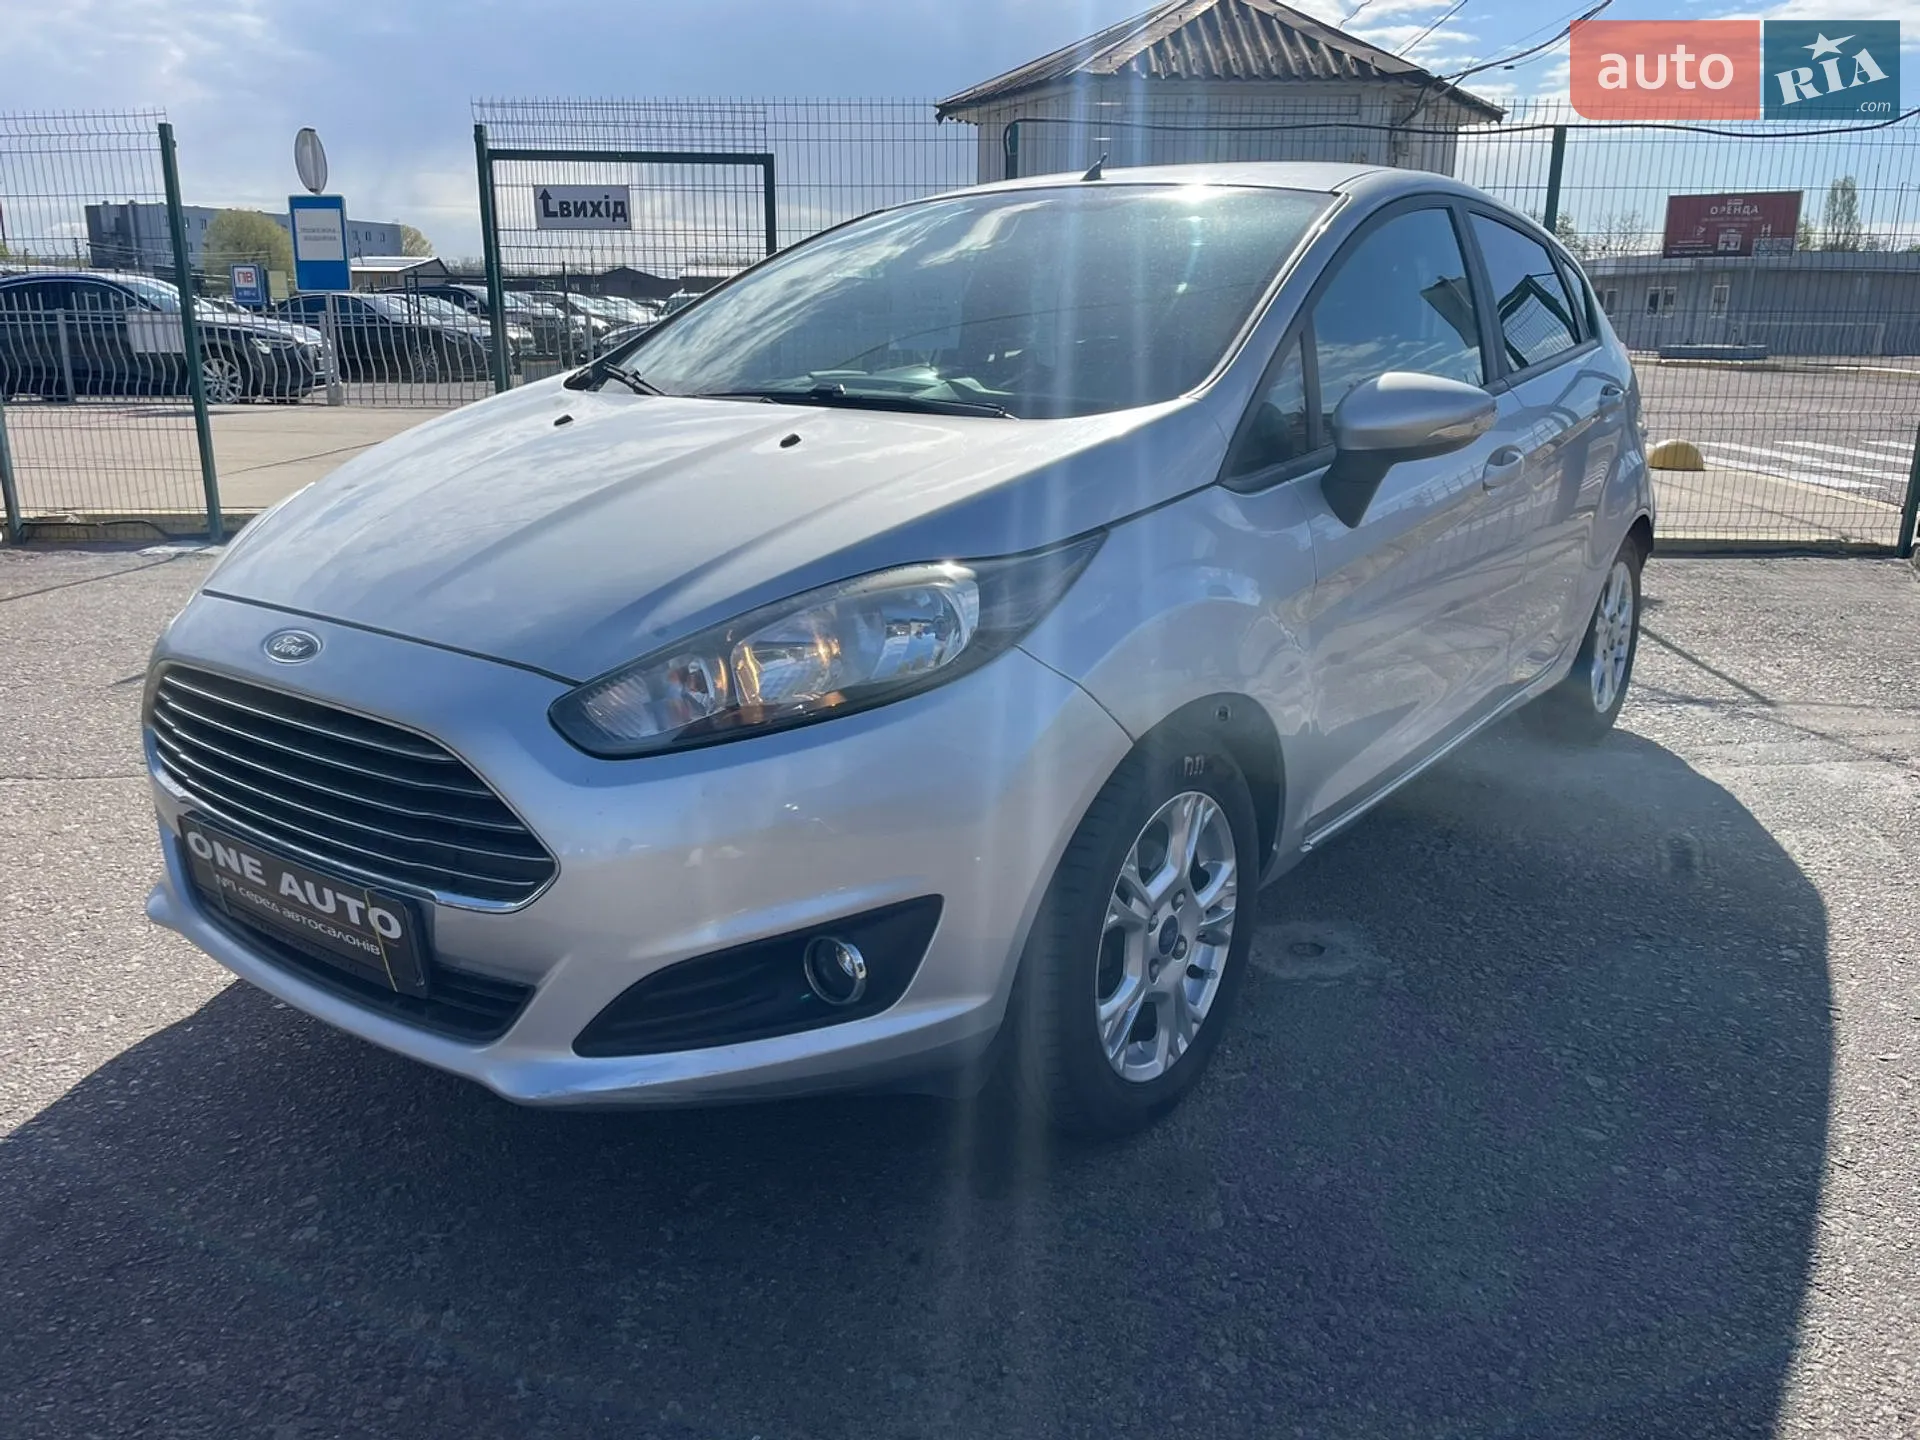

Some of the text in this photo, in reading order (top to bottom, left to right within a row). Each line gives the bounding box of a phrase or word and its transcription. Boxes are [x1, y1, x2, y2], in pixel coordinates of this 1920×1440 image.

[559, 194, 628, 222] вихід
[1710, 205, 1760, 216] ОРЕНДА
[187, 831, 403, 940] ONE AUTO
[239, 886, 281, 914] серед
[281, 906, 382, 956] автосалонів
